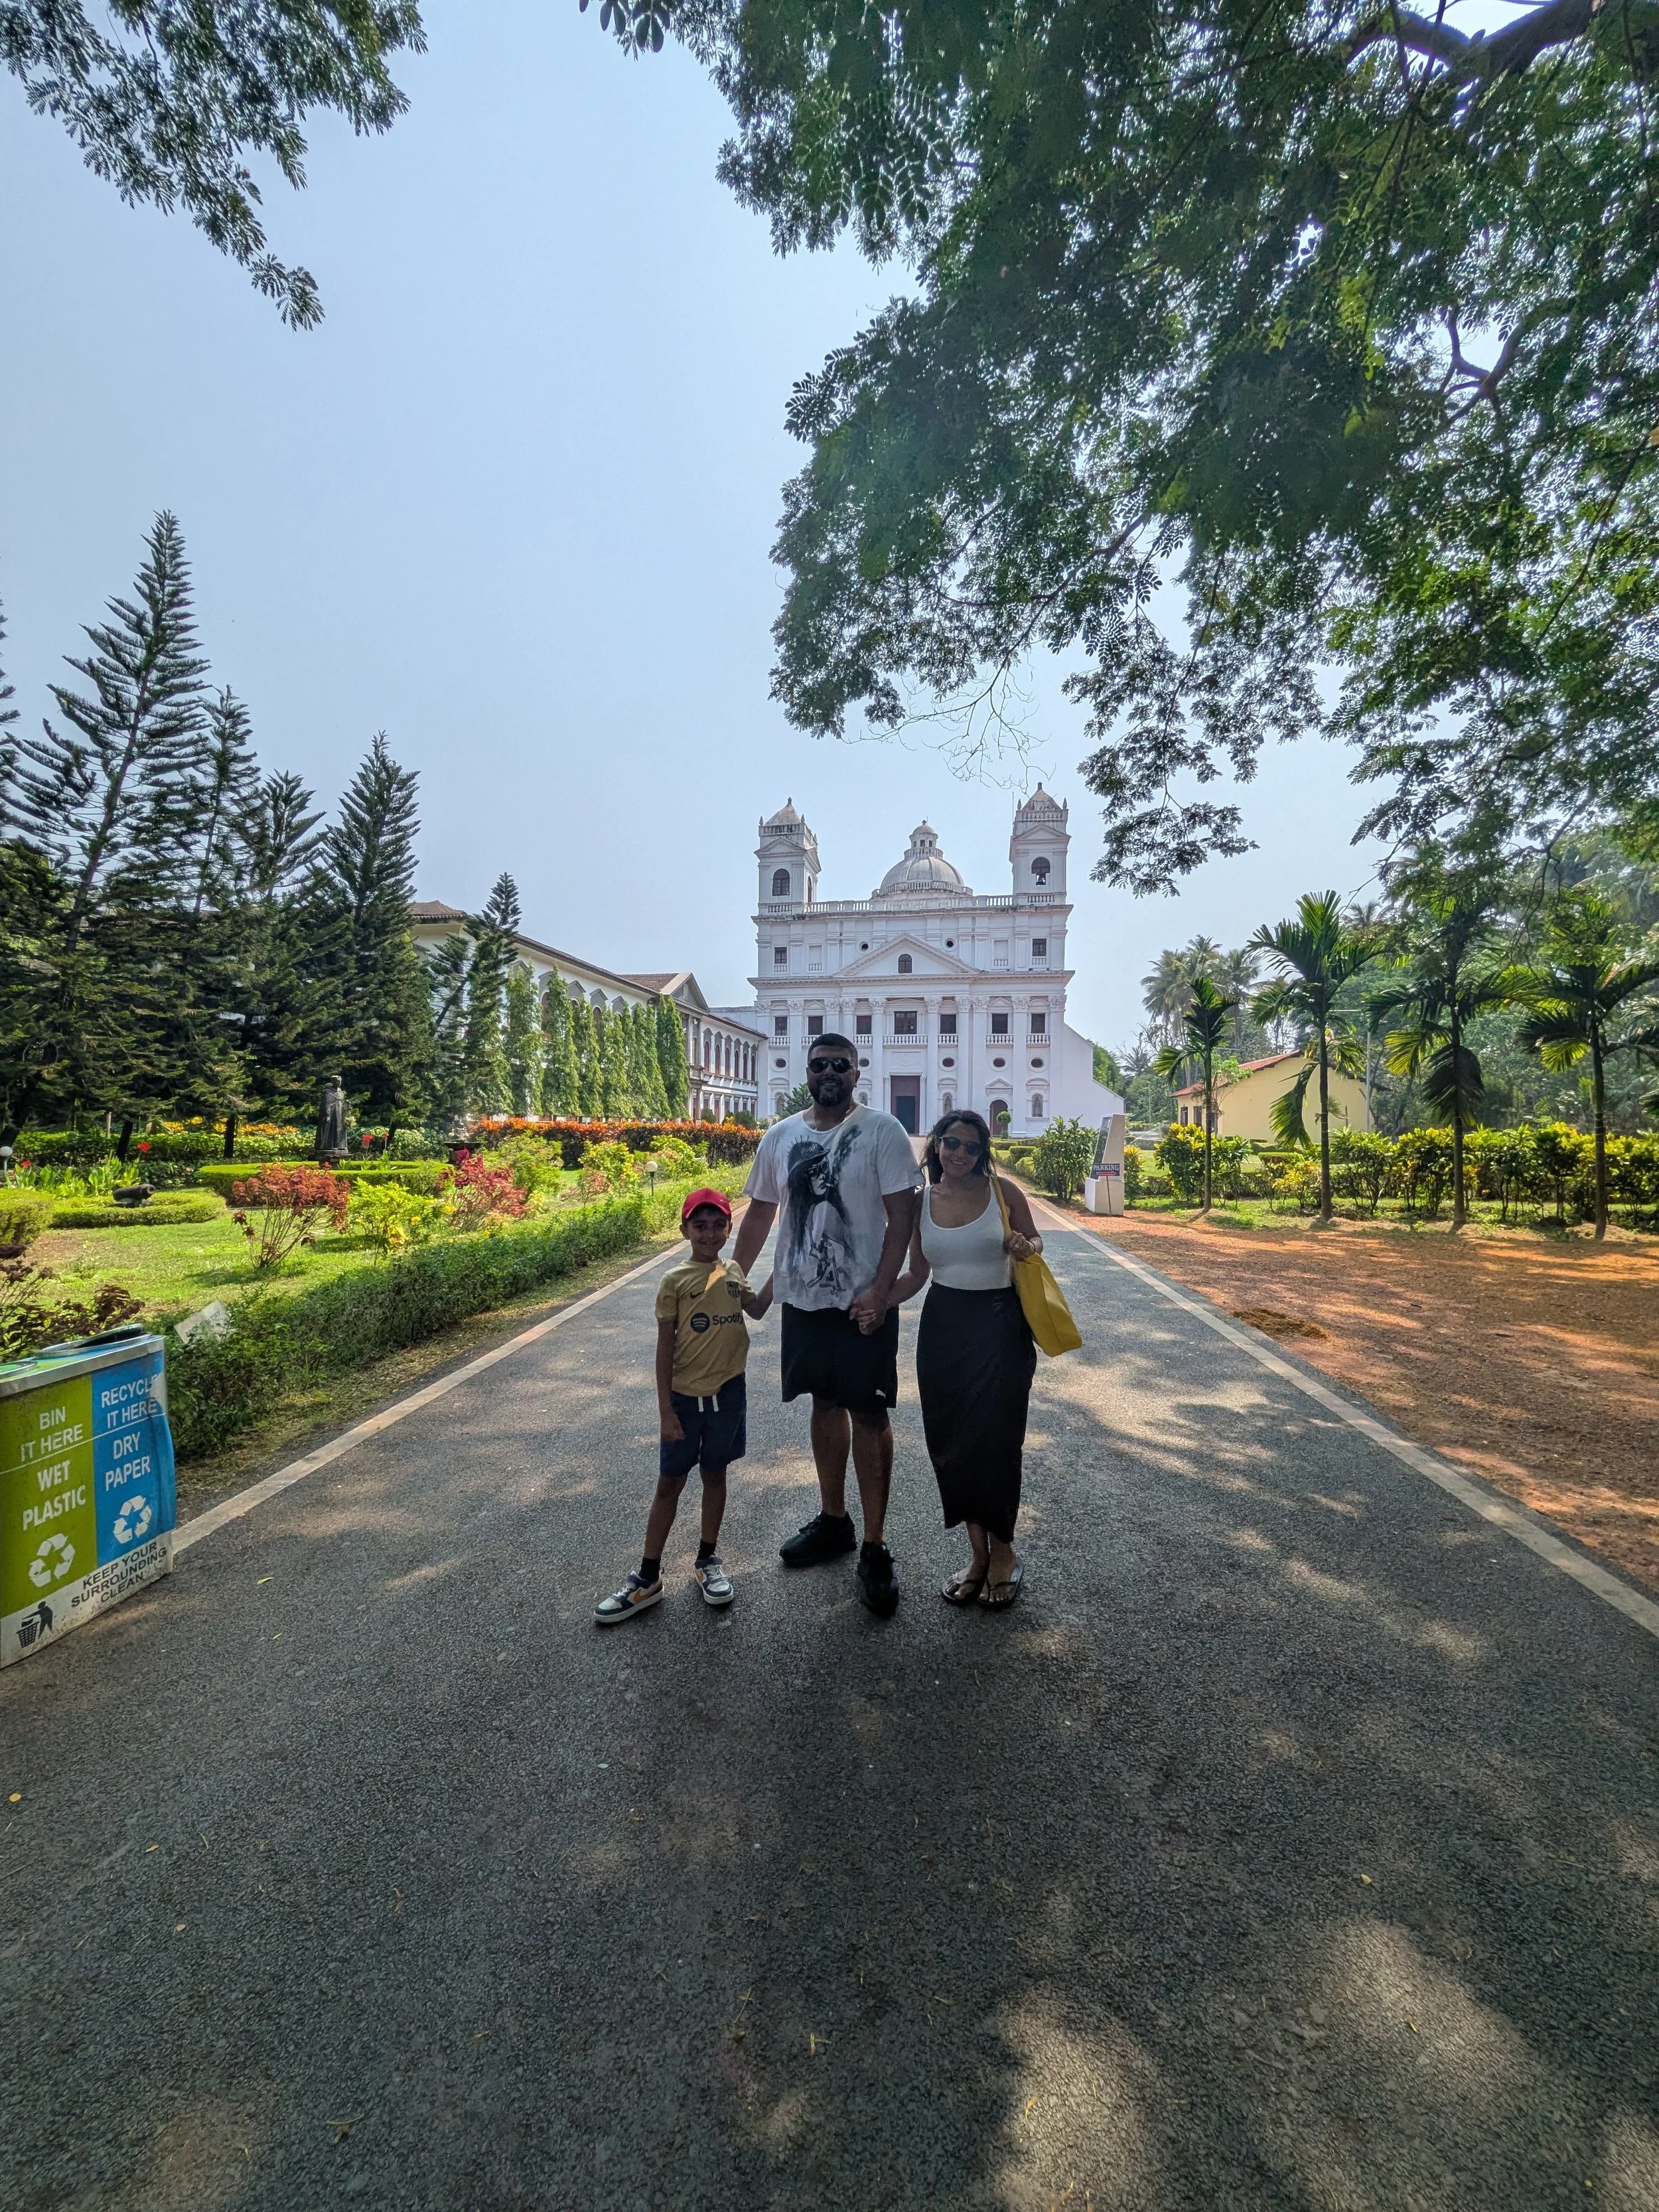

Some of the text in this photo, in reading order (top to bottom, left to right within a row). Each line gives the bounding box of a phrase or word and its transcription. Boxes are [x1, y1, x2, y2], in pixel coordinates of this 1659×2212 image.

[712, 1312, 744, 1326] Spotify
[39, 1406, 66, 1430] BIN
[107, 1398, 157, 1429] IT HERE
[21, 1423, 84, 1462] IT HERE
[113, 1432, 141, 1460] DRY
[37, 1459, 71, 1492] WET
[106, 1455, 151, 1492] PAPER
[23, 1484, 86, 1532] PLASTIC
[70, 1546, 167, 1609] SURROUNDING
[82, 1541, 157, 1590] KEEP YOUR
[100, 1571, 144, 1603] CLEAN
